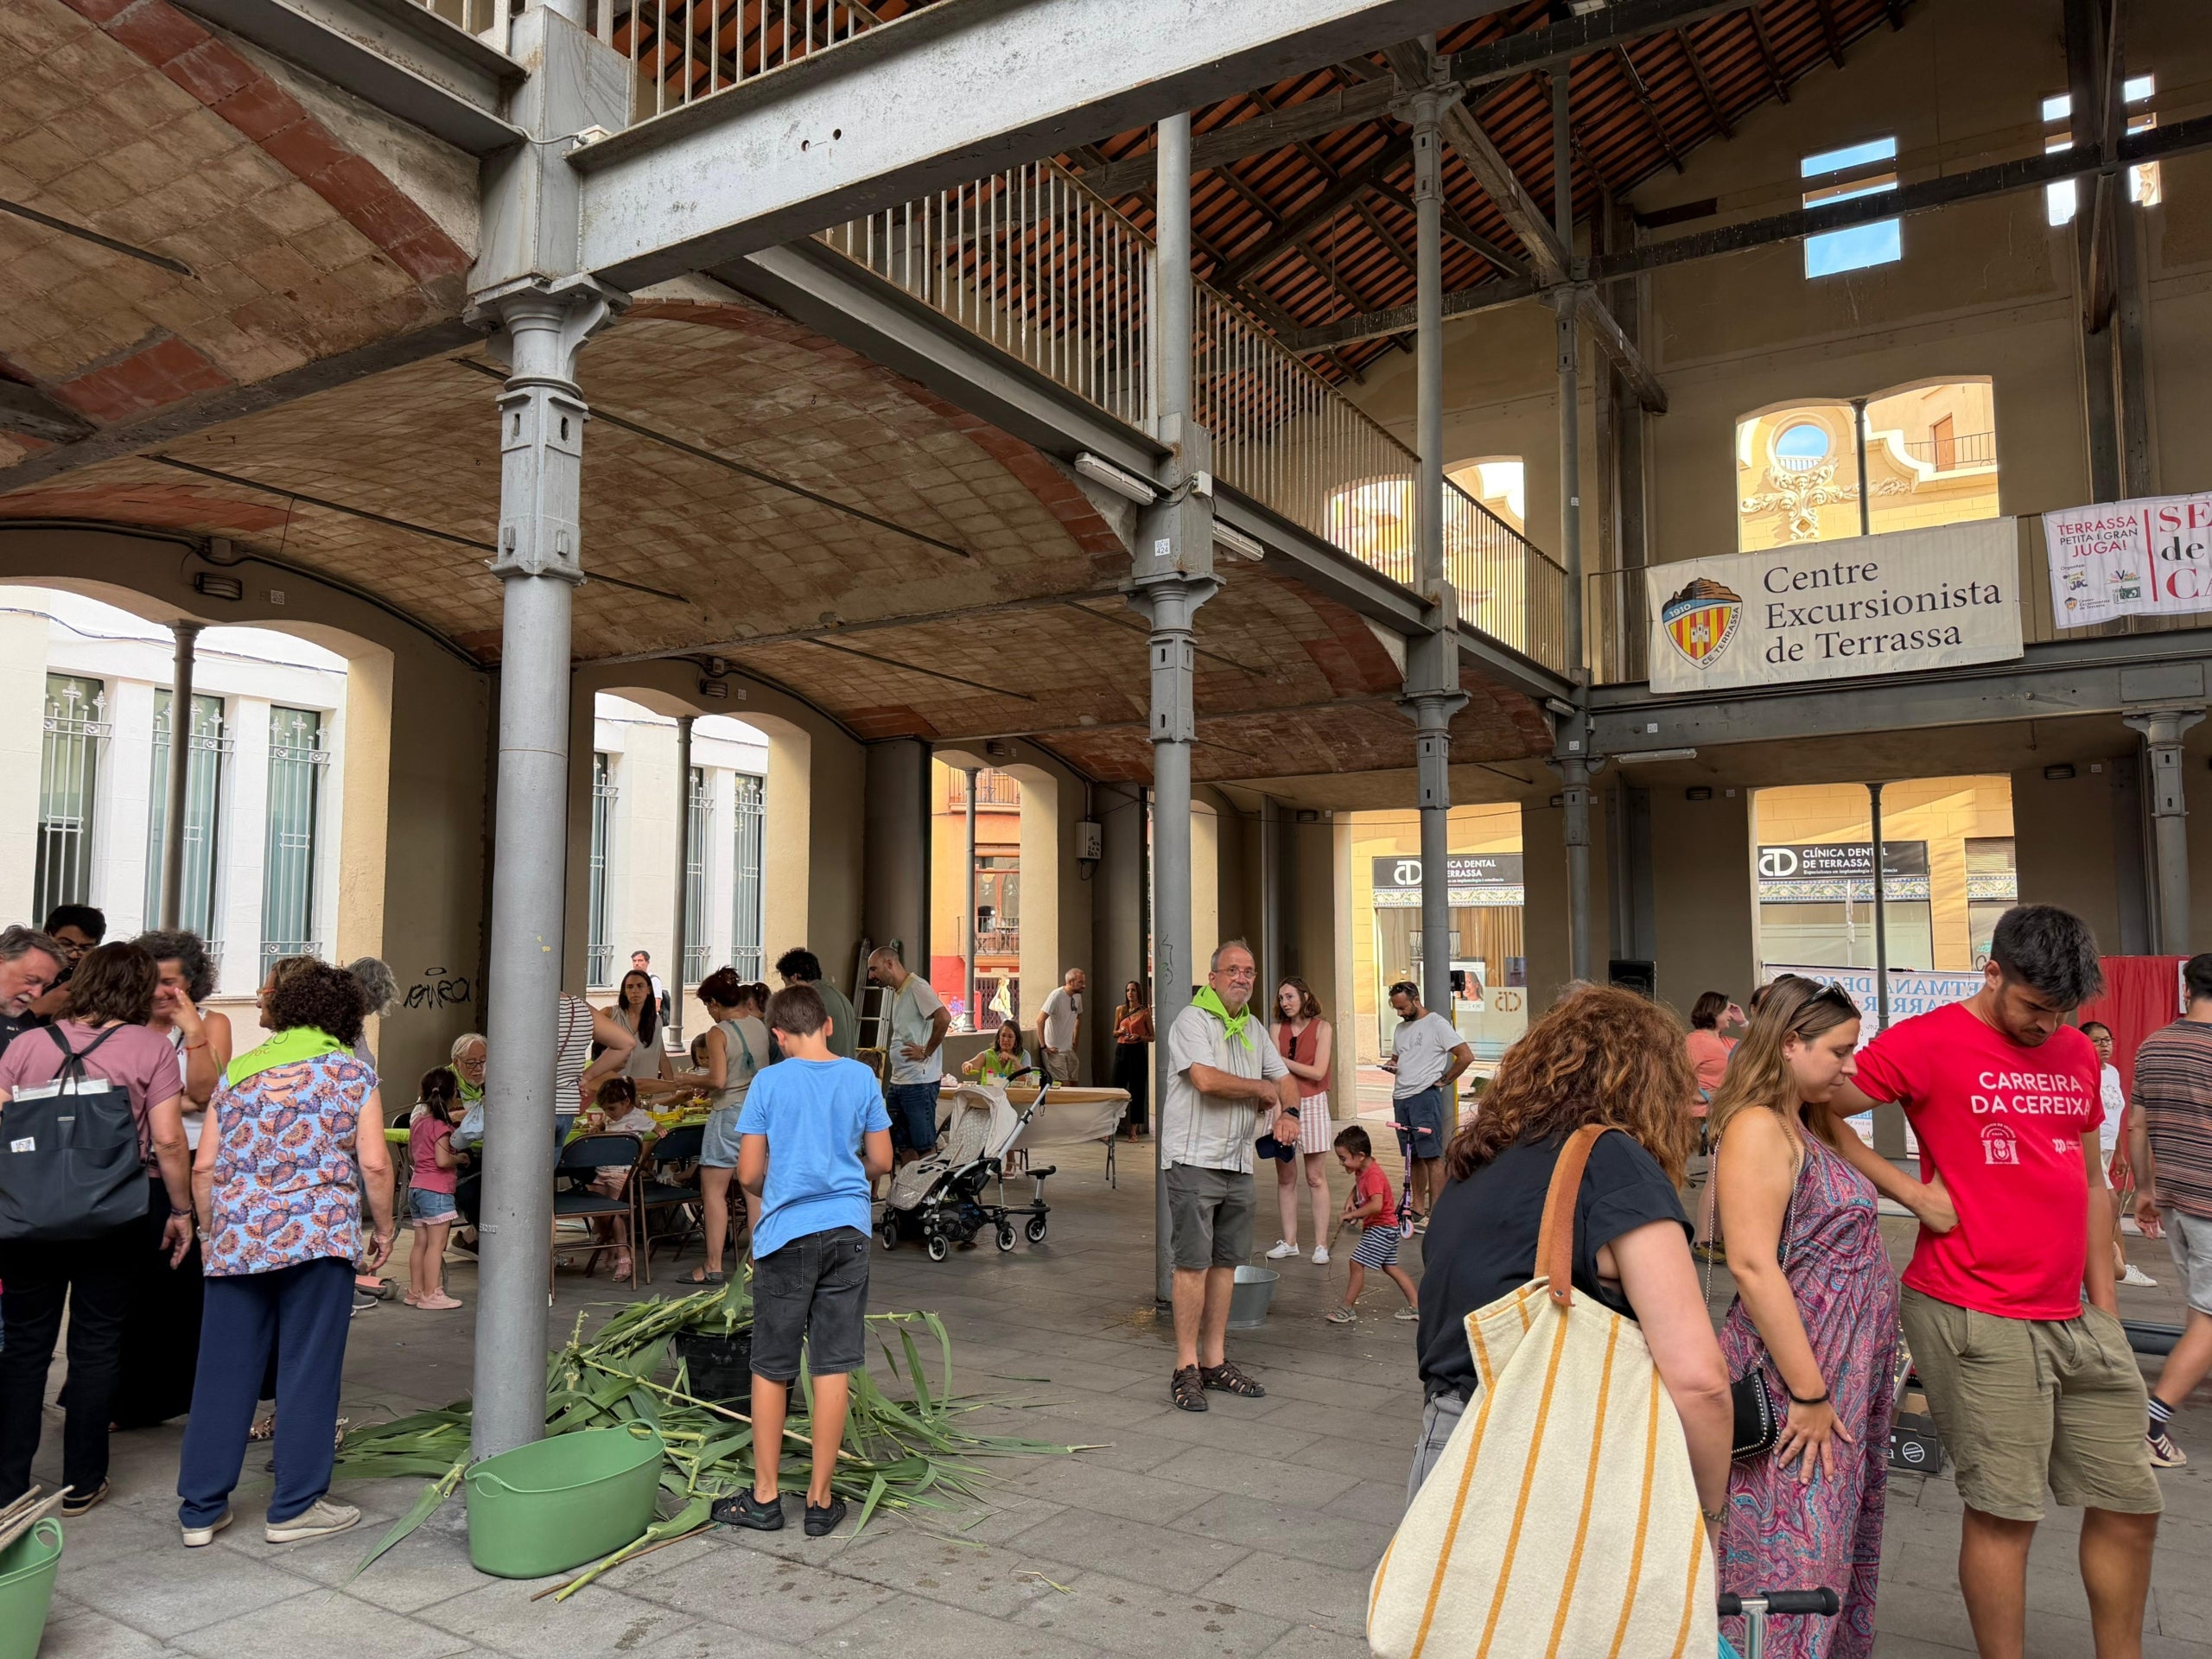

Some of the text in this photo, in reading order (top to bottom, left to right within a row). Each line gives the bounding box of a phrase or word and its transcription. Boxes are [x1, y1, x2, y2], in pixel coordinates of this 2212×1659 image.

[2057, 515, 2138, 536] TERRASSA
[2060, 534, 2094, 546] PETITA
[2103, 528, 2138, 540] GRAN
[2072, 539, 2127, 557] JUGA!
[2161, 537, 2205, 561] de
[1764, 562, 1878, 594] Centre
[1669, 603, 1691, 617] 1910
[1764, 581, 2003, 630] Excursionista
[1701, 607, 1740, 665] CE TERRASSA
[1765, 625, 1963, 664] de Terrassa
[1464, 859, 1497, 868] DENTAL
[1802, 848, 1889, 858] CLÍNICA DENTL
[1802, 858, 1871, 868] DE TERRASSA
[1447, 868, 1483, 878] ERRASSA
[1979, 1071, 2083, 1092] CARREIRA
[1971, 1095, 2090, 1116] DA CEREIXA
